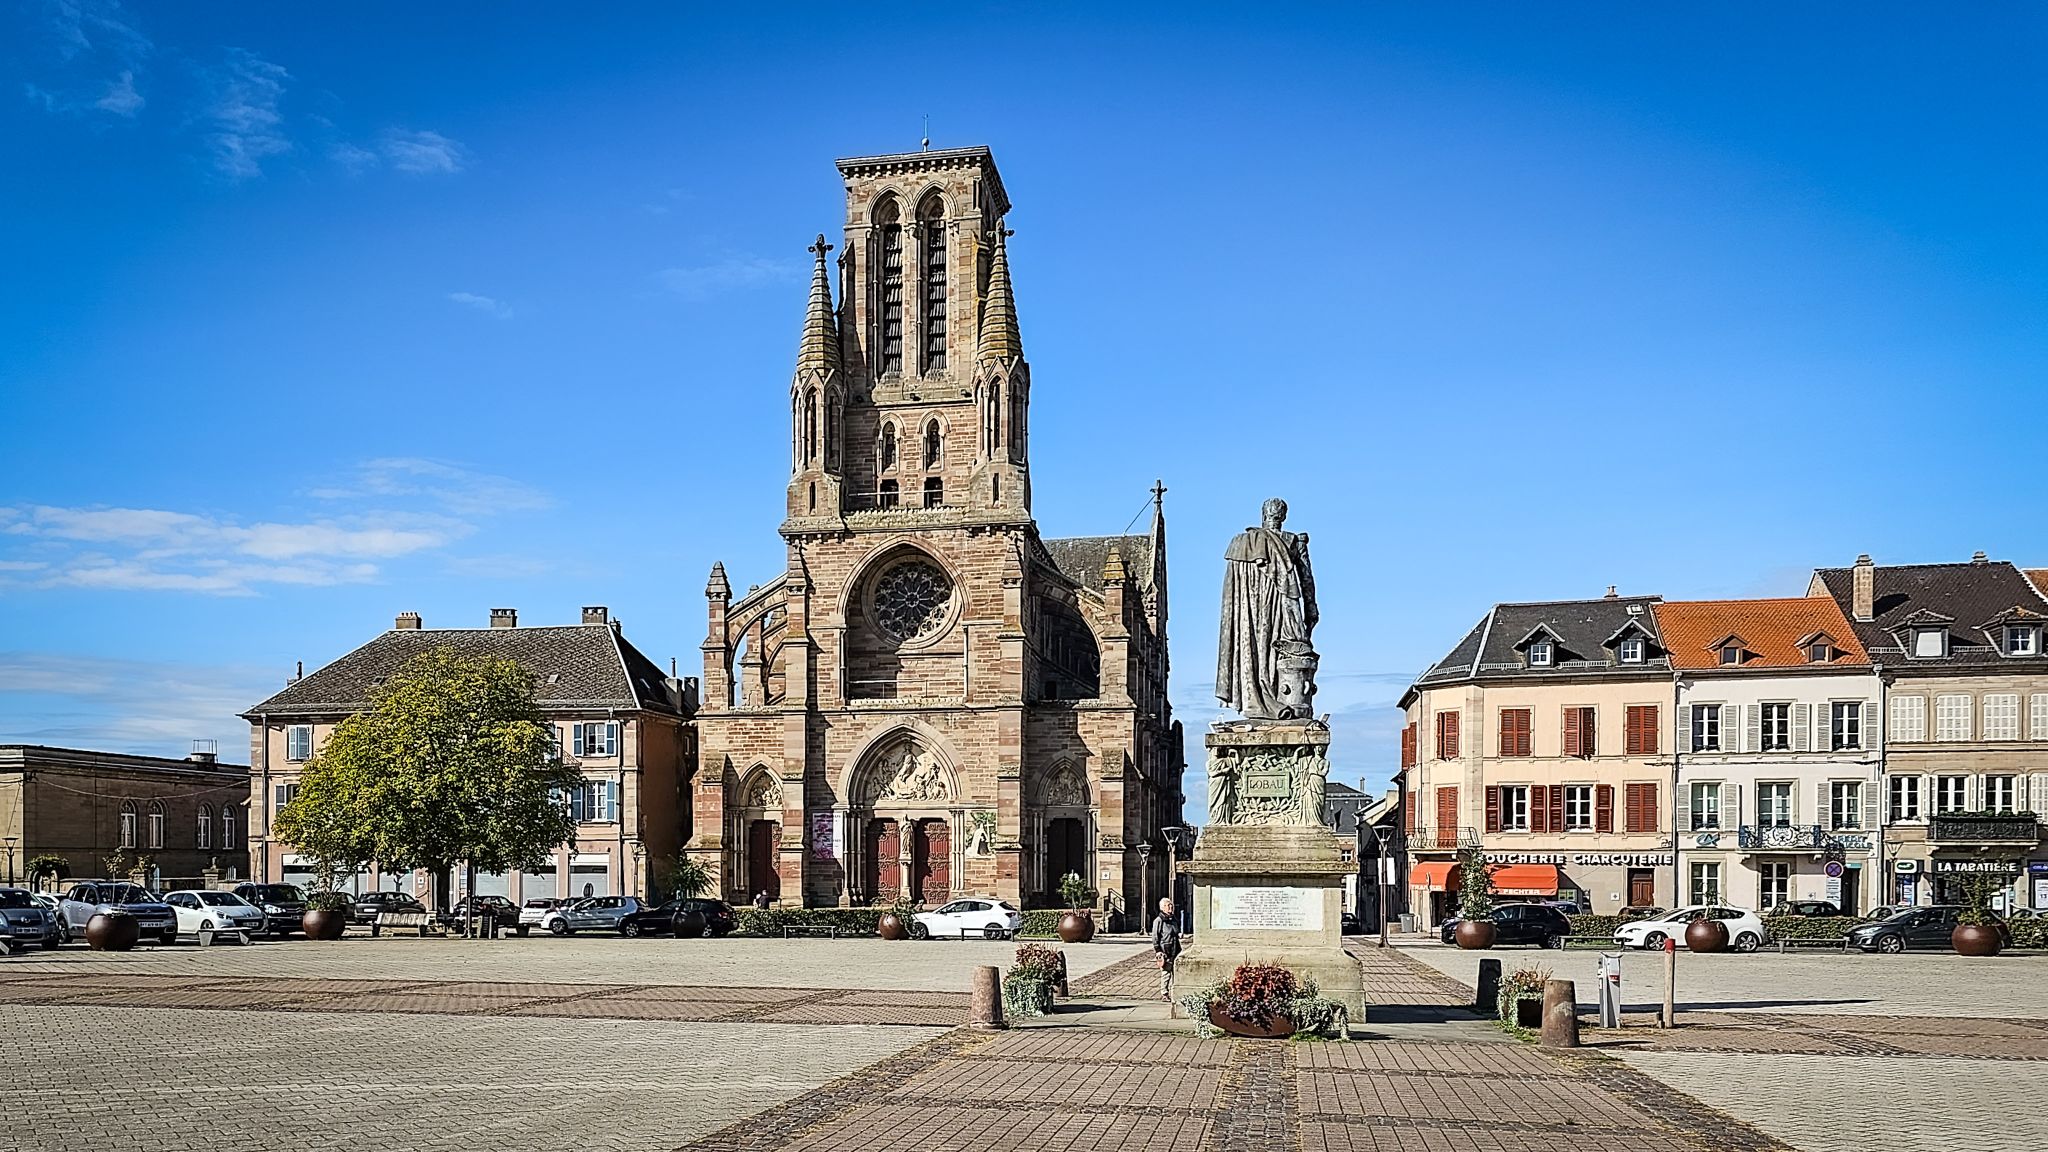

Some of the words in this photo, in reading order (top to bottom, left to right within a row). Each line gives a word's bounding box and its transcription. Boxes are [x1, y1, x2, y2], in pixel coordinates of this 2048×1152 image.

[1249, 779, 1284, 789] LOBAU
[1485, 853, 1564, 864] OUCHERIE
[1573, 853, 1673, 865] CHARCUTERIE
[1937, 862, 1953, 872] LA
